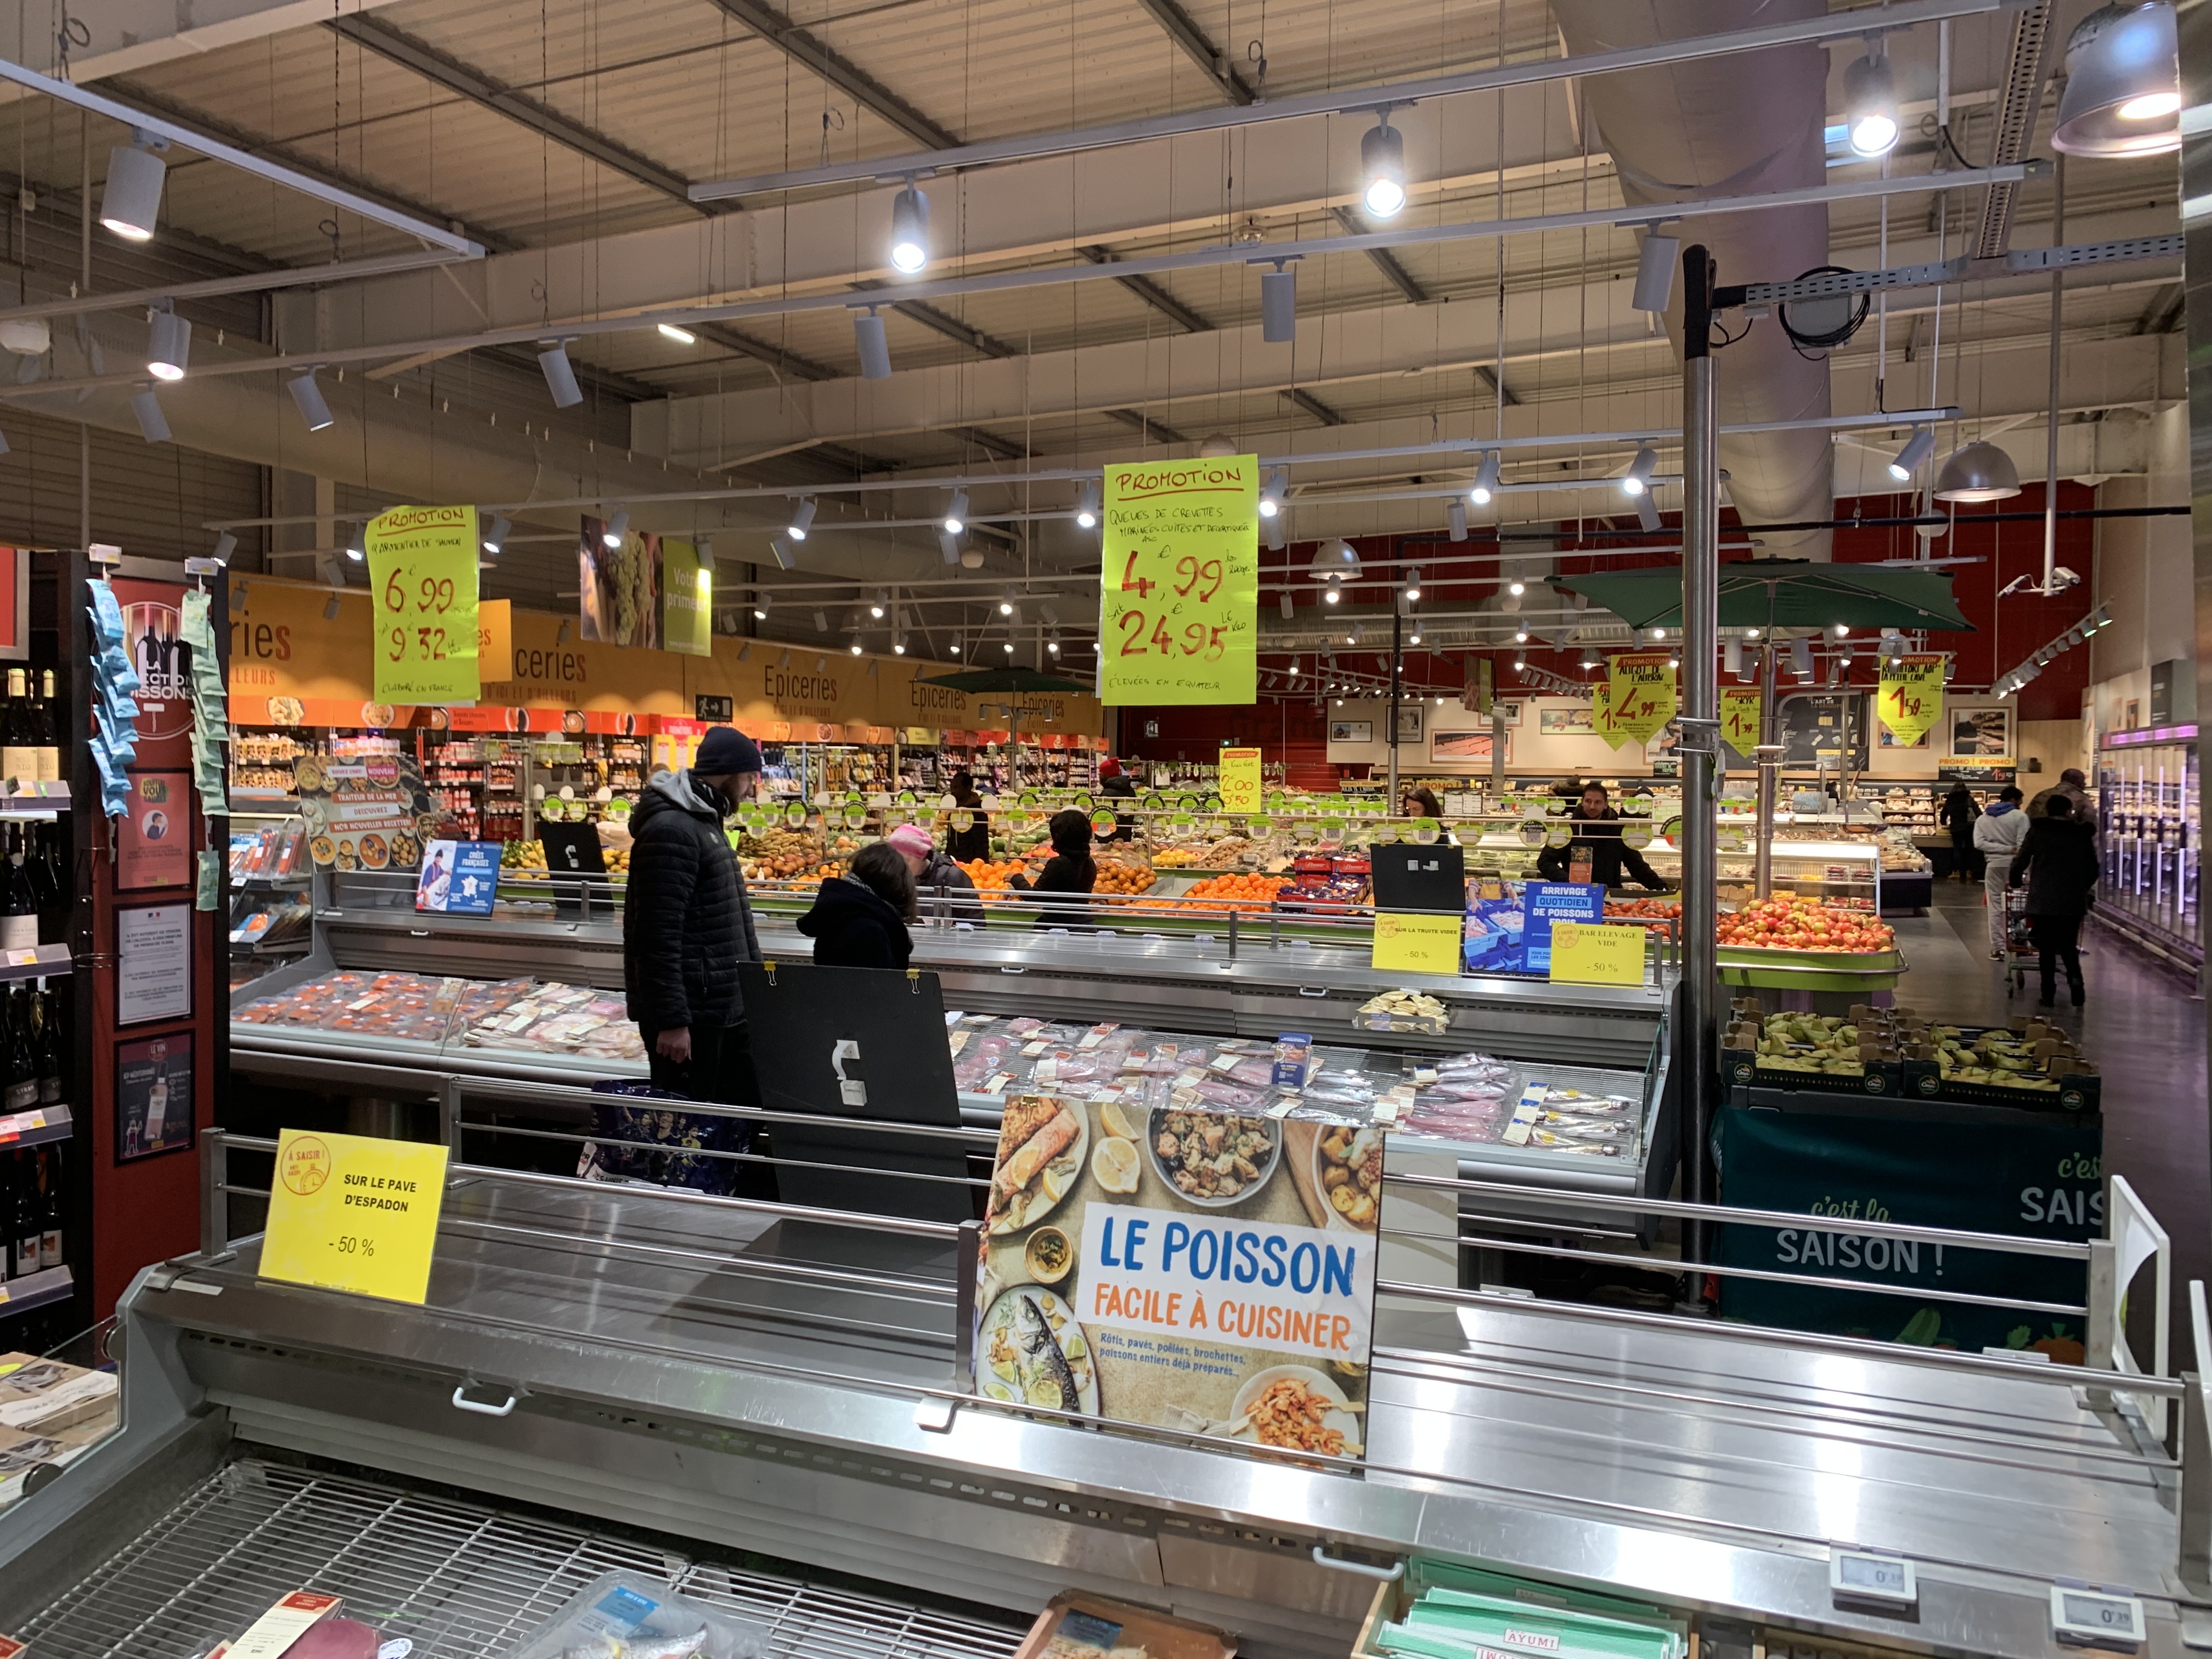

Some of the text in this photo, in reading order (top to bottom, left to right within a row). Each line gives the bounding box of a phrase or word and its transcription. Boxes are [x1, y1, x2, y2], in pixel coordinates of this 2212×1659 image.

[1116, 463, 1241, 492] PROMOTION
[377, 507, 464, 529] PROMOTION
[1110, 507, 1223, 525] QUEUES DE CREVETTES
[1161, 523, 1190, 533] CUITES
[422, 538, 431, 548] DE
[667, 590, 707, 612] primeur
[229, 610, 291, 661] ries
[146, 661, 161, 670] LA
[516, 642, 586, 682] ceries
[1619, 666, 1646, 675] ALIGOT
[1882, 664, 1919, 673] RUEFORT
[230, 667, 275, 685] LLEURS
[765, 665, 837, 703] Epiceries
[1177, 680, 1220, 690] EQUATEUR
[130, 686, 196, 700] ISSONS
[429, 684, 453, 692] FRANCE
[912, 680, 966, 712] Epiceries
[1542, 886, 1588, 896] ARRIVAGE
[1539, 898, 1588, 906] QUOTIDIEN
[1533, 908, 1594, 918] DE POISSONS
[1593, 963, 1605, 971] 50
[1608, 963, 1618, 972] %
[296, 1150, 320, 1160] SAISIR
[344, 1174, 417, 1193] SUR LE PAVE
[345, 1194, 409, 1212] D'ESPADON
[338, 1236, 357, 1254] 50
[362, 1239, 375, 1257] %
[1777, 1229, 1918, 1273] SAISON
[1100, 1217, 1355, 1297] LE POISSON
[1094, 1283, 1351, 1351] FACILE À CUISINER
[1101, 1333, 1245, 1365] Rôtis, pavés, poêlées, brochettes,
[1099, 1348, 1137, 1361] poissons
[1140, 1354, 1170, 1366] entiers
[1172, 1358, 1190, 1370] déjà
[1509, 1633, 1554, 1648] AYUMI
